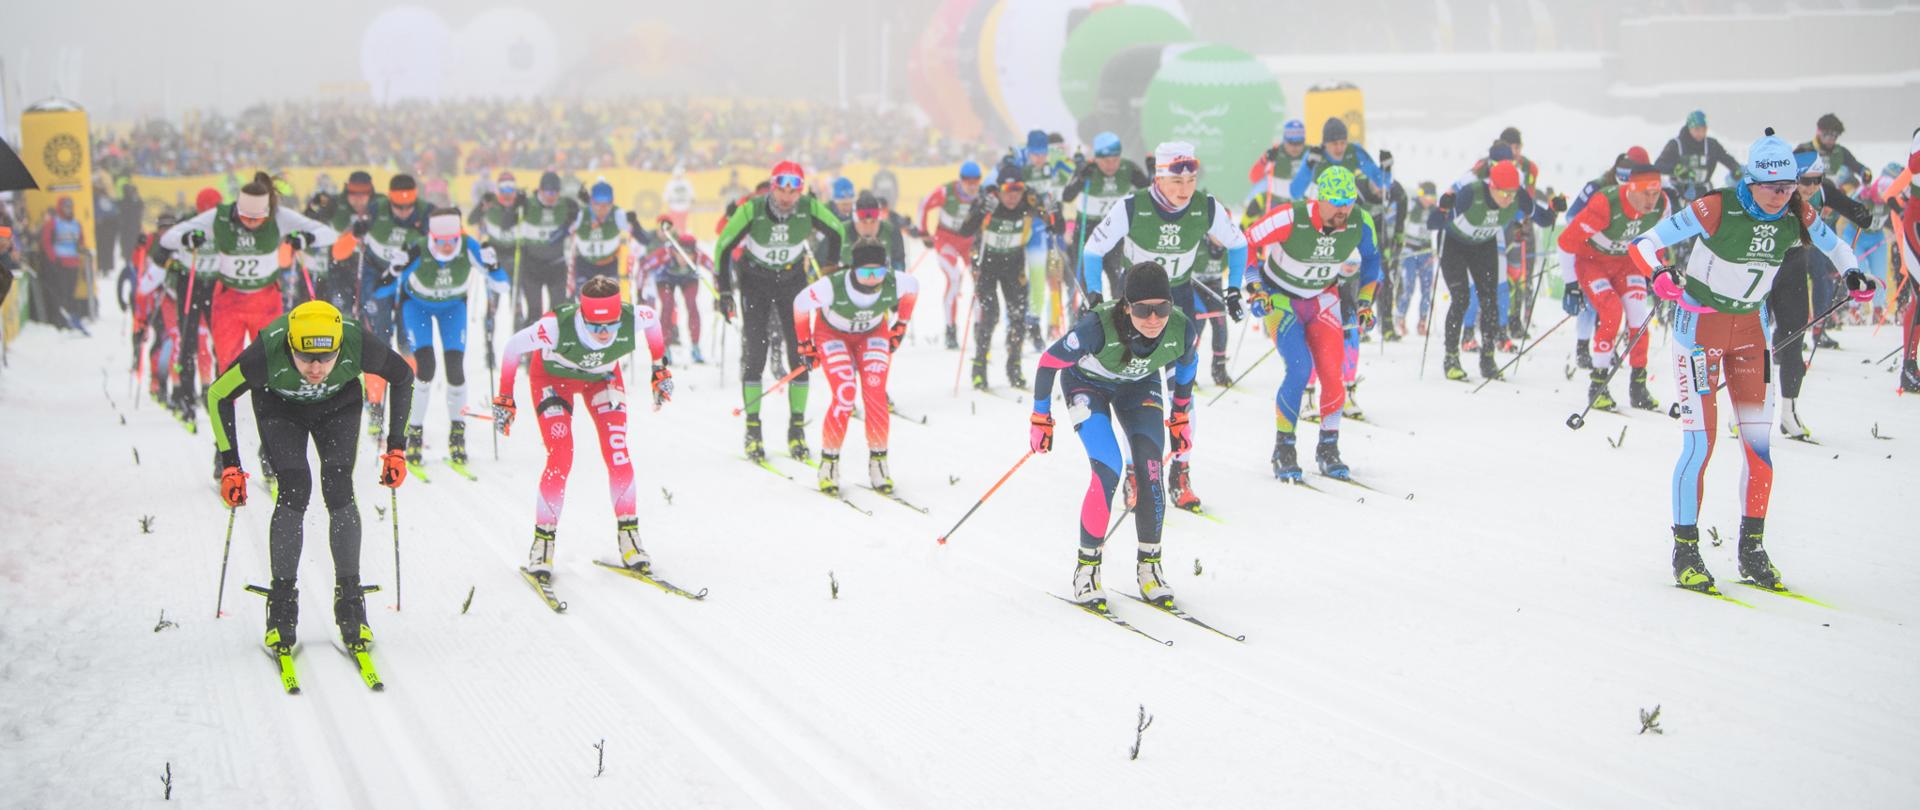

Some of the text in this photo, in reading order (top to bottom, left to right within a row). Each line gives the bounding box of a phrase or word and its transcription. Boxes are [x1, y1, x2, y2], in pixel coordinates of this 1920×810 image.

[237, 235, 257, 247] 50
[1158, 235, 1181, 247] 50
[1749, 237, 1776, 252] 50
[1312, 246, 1335, 256] 50
[233, 259, 259, 277] 22
[1743, 268, 1764, 299] 7
[829, 364, 857, 418] POL
[608, 421, 631, 466] POL
